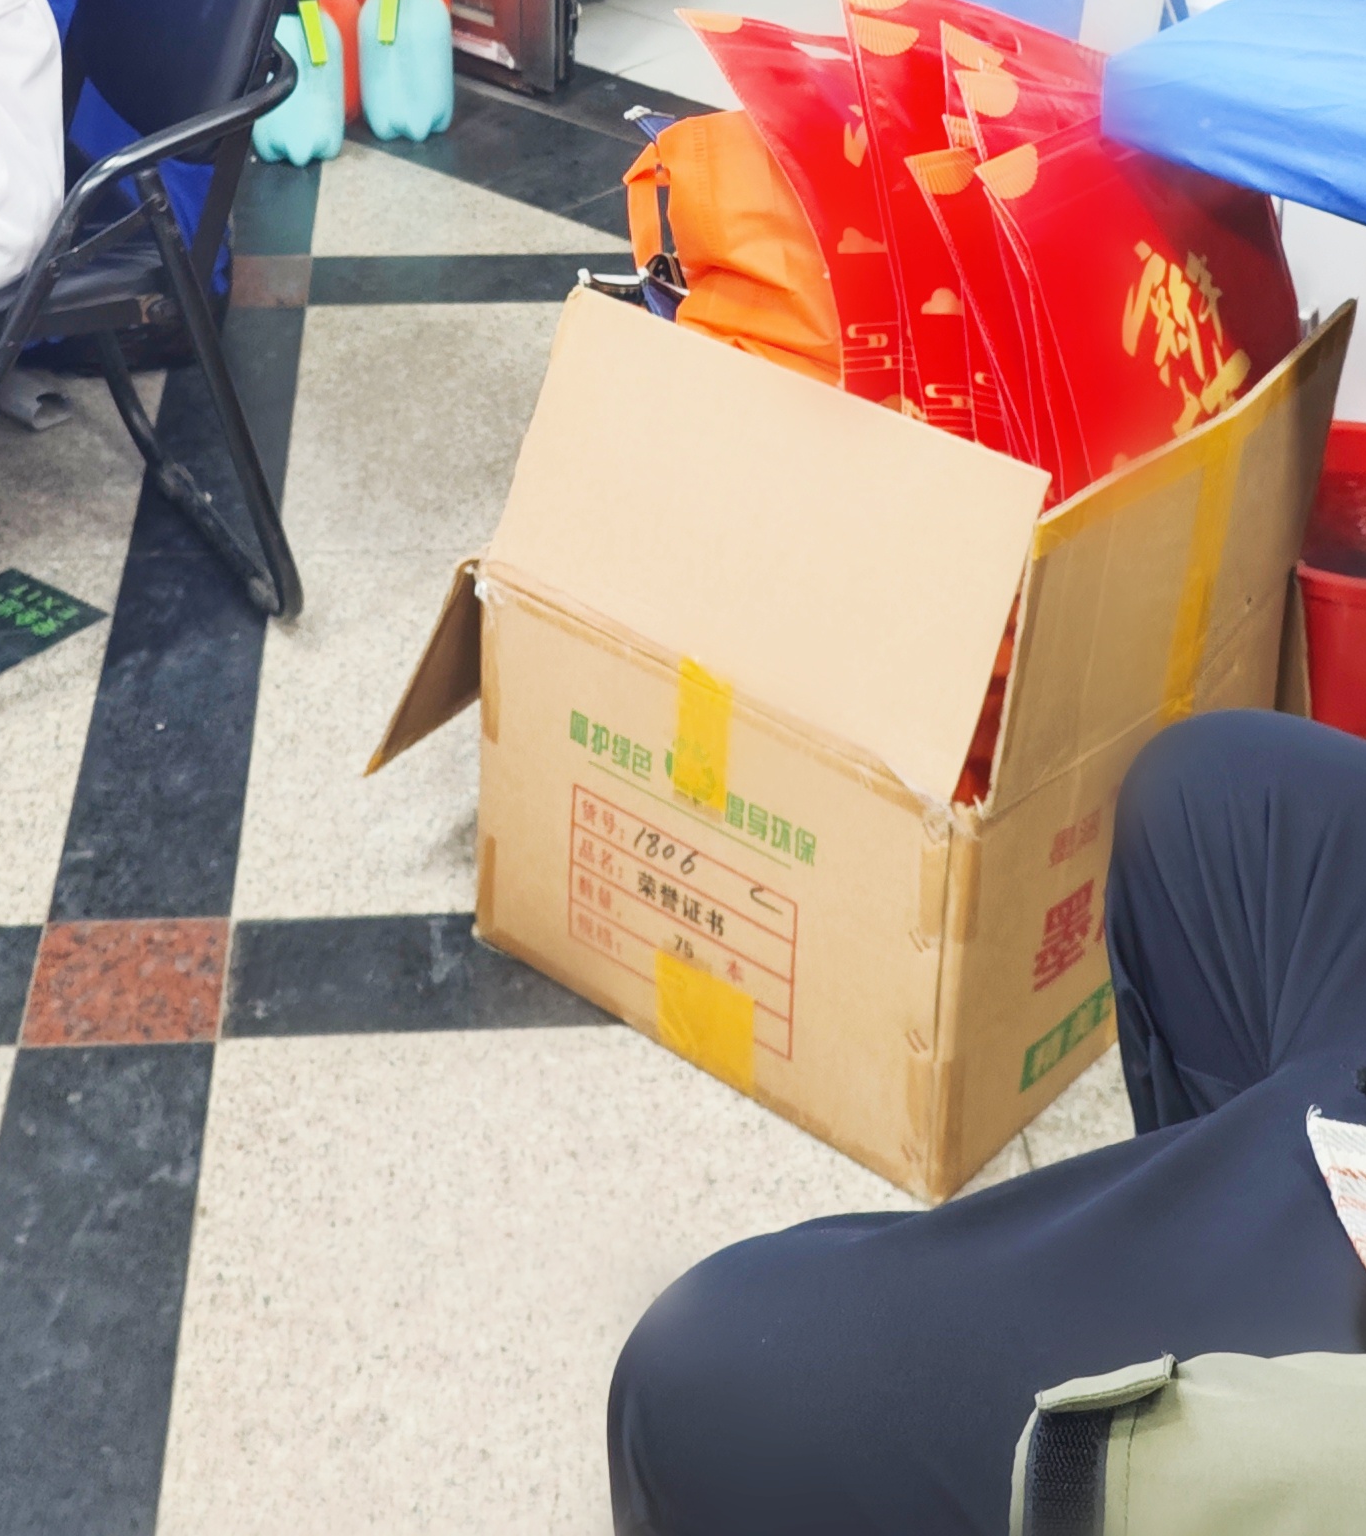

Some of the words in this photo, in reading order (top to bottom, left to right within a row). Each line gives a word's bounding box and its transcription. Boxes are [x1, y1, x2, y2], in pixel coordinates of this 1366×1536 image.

[633, 827, 699, 875] 1806
[637, 870, 725, 937] 荣誉证书
